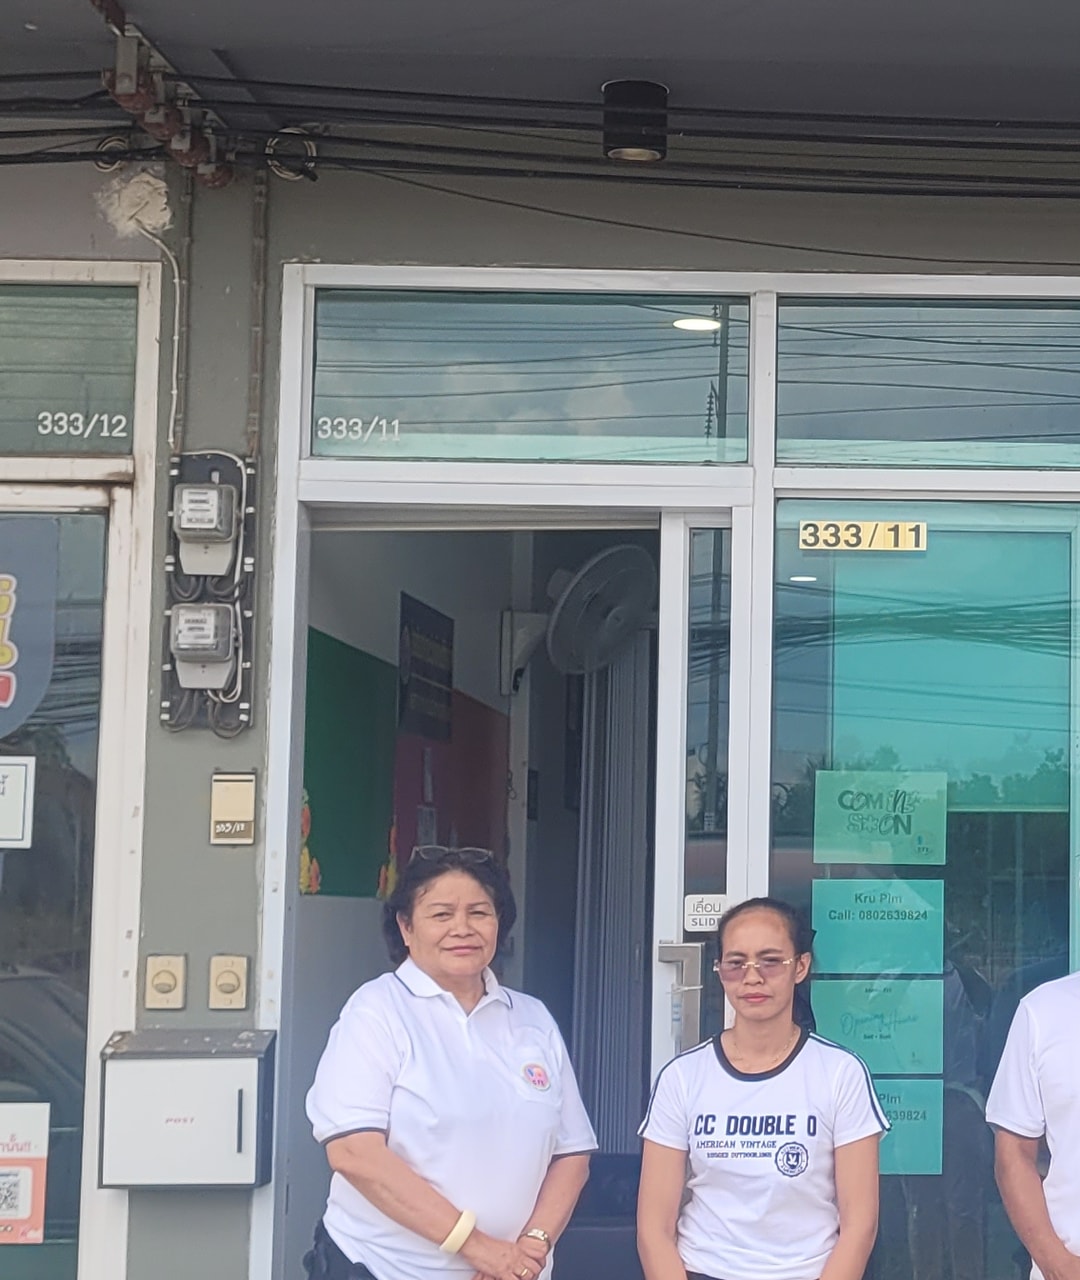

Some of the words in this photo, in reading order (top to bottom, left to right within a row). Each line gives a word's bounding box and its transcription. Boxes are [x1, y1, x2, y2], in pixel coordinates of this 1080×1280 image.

[37, 411, 129, 438] 333/12
[316, 415, 402, 442] 333/11
[801, 522, 921, 549] 333/11
[854, 893, 876, 904] Kru
[691, 917, 716, 927] SLID
[829, 909, 855, 921] Call:
[858, 909, 928, 921] 0802639824
[694, 1114, 717, 1136] CC
[725, 1114, 797, 1136] DOUBLE
[695, 1140, 736, 1149] AMERICAN
[739, 1140, 777, 1149] VINTAGE
